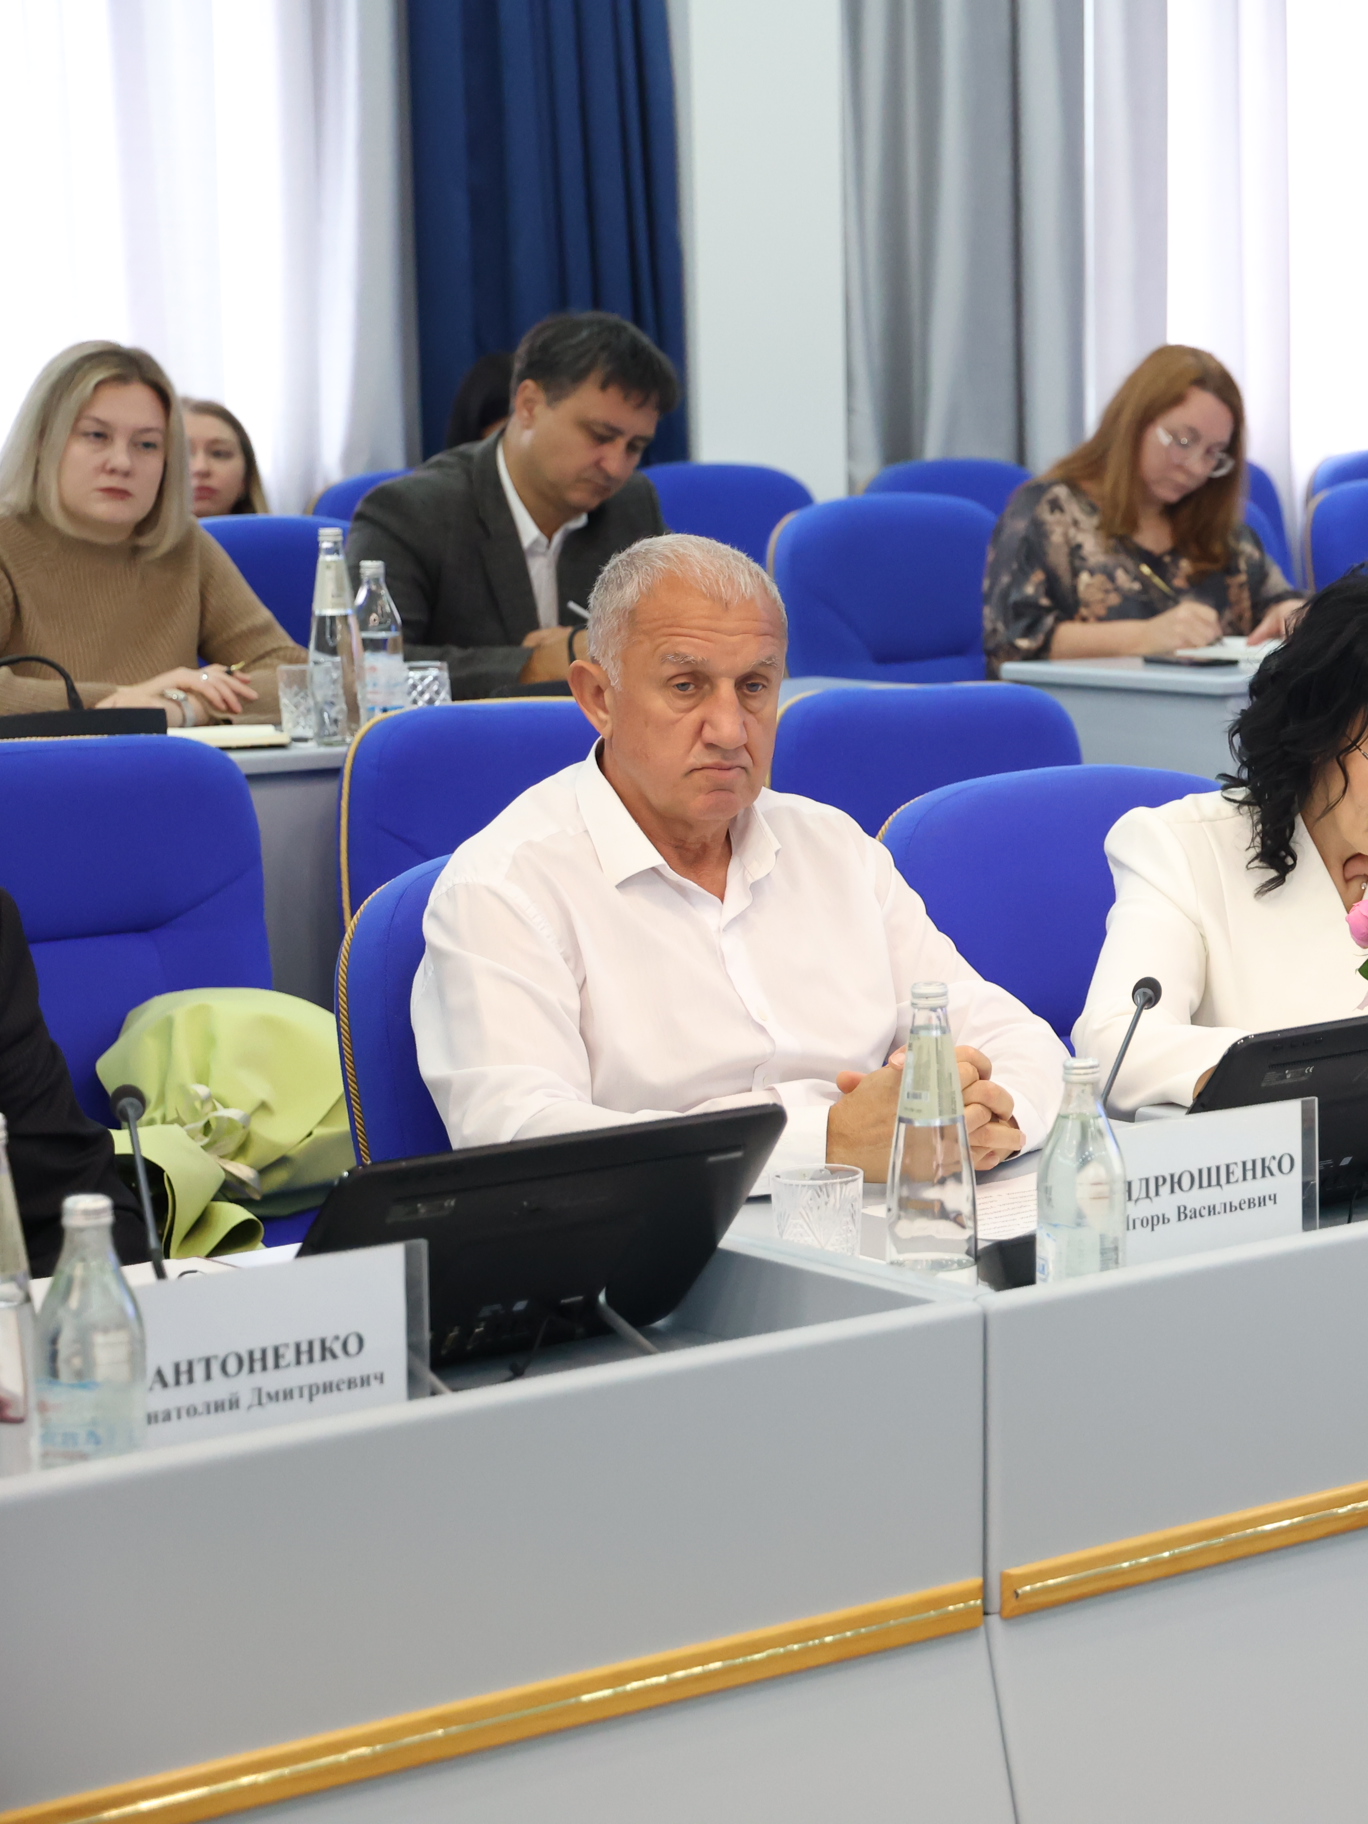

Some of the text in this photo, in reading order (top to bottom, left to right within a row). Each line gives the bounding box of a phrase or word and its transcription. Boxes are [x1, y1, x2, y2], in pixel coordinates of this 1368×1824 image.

[1126, 1152, 1295, 1206] ДРЮЩЕНКО
[1176, 1192, 1278, 1223] Васильевич
[147, 1331, 366, 1392] АНТОНЕНКО
[146, 1371, 386, 1426] натолий Дмитриевич
